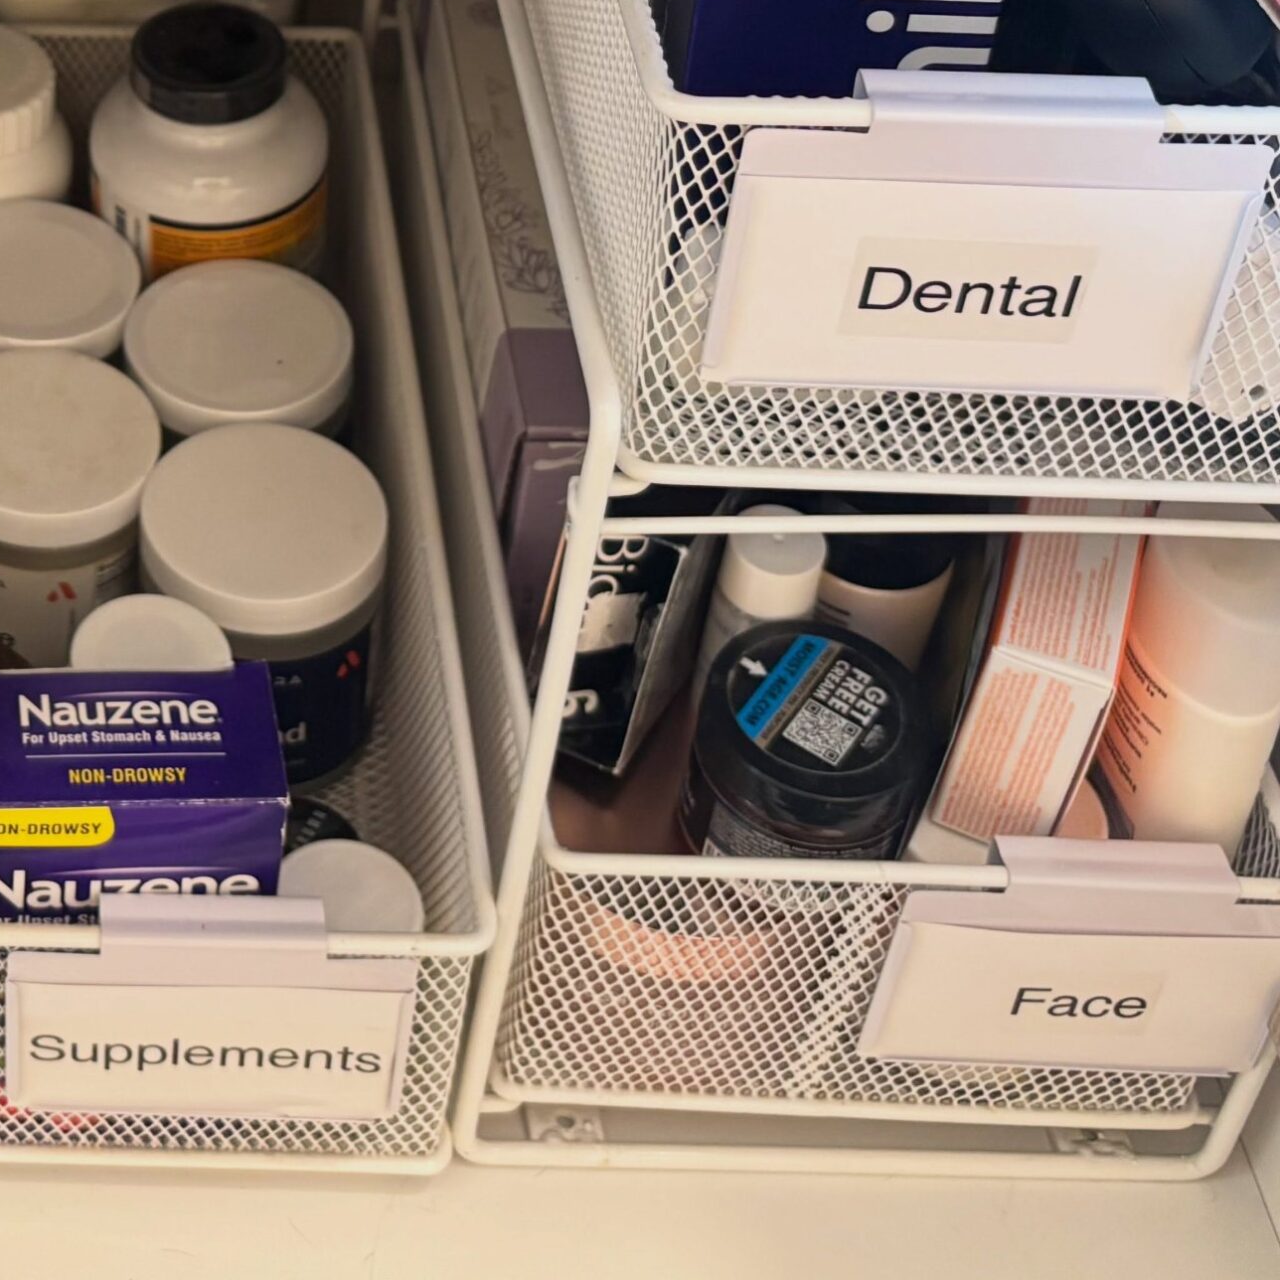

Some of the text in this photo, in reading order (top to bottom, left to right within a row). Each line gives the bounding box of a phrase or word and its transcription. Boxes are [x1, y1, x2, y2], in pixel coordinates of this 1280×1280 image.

[857, 265, 1083, 320] Dental
[813, 659, 851, 701] CREAM
[827, 666, 872, 715] FREE
[18, 694, 218, 727] Nauzene
[849, 685, 890, 727] GET
[22, 728, 222, 746] For Upset Stomach & Nausea
[68, 767, 187, 785] NON-DROWSY
[1009, 985, 1148, 1020] Face
[28, 1033, 382, 1076] Supplements
